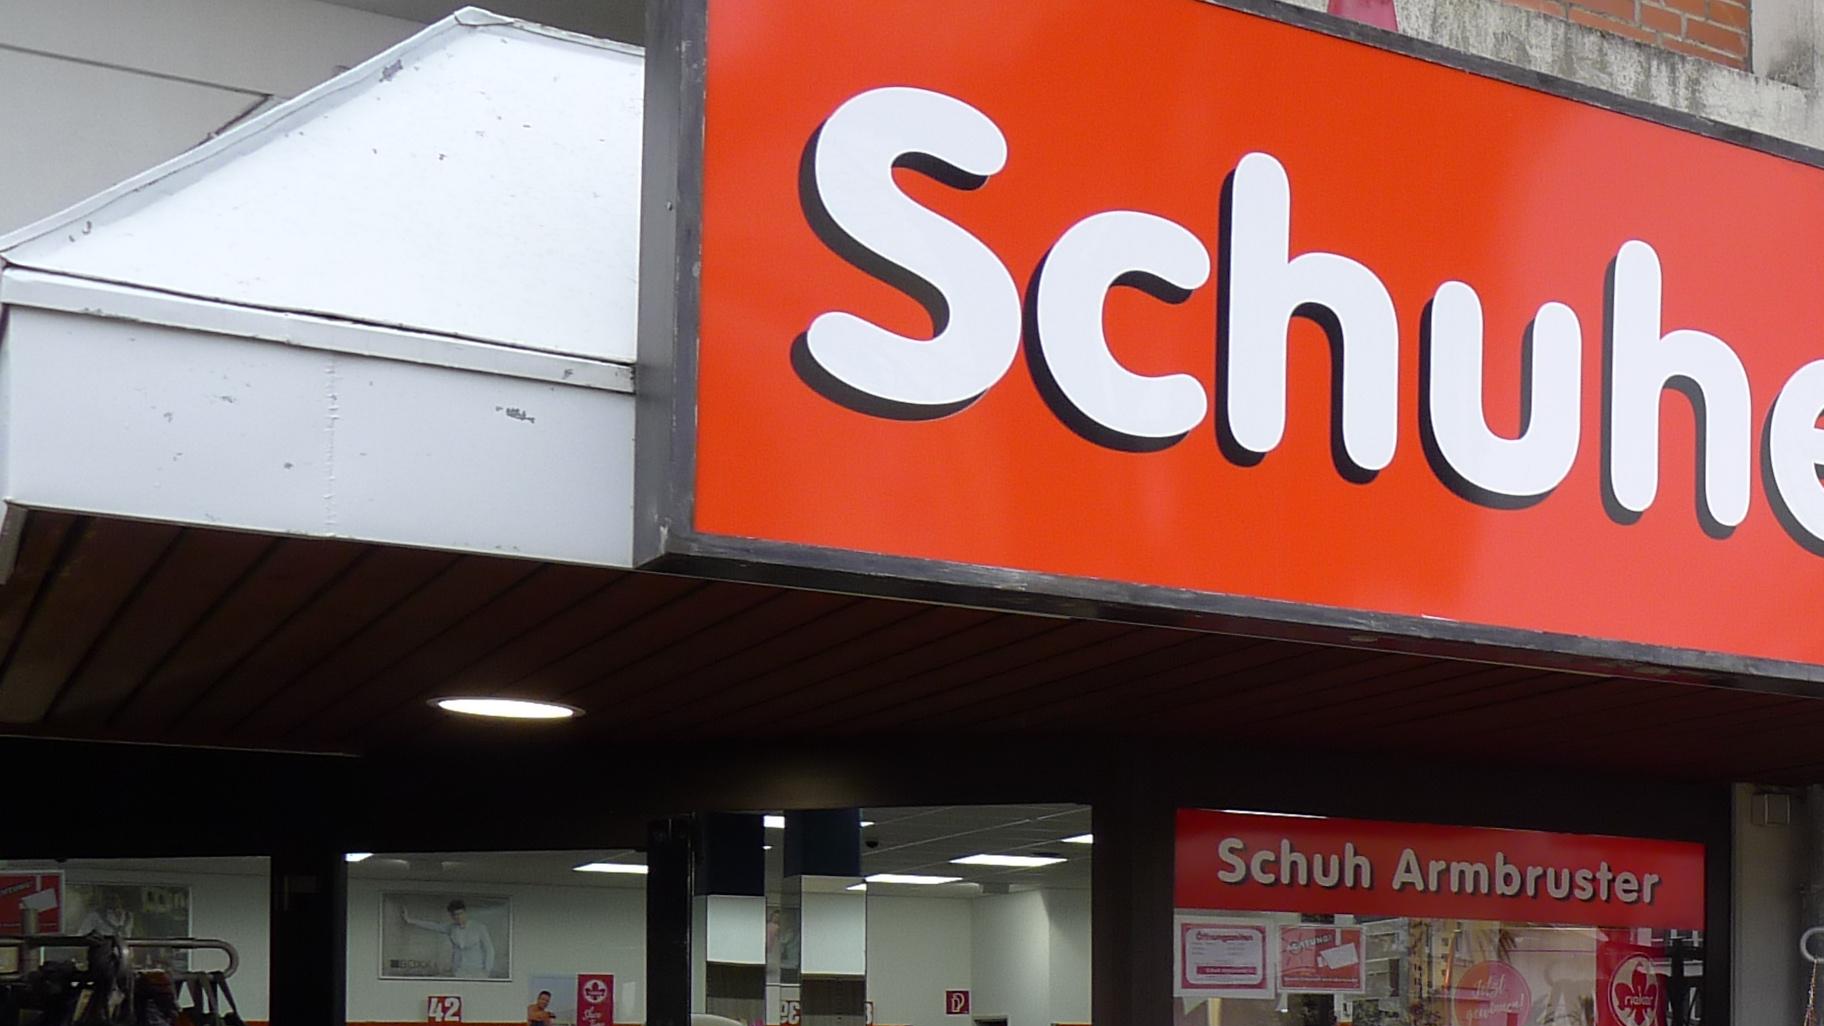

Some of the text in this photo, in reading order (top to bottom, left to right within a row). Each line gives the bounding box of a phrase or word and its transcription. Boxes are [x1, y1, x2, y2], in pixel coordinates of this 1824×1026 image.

[1217, 837, 1661, 904] Schuh Armbruster
[428, 998, 460, 1022] 42
